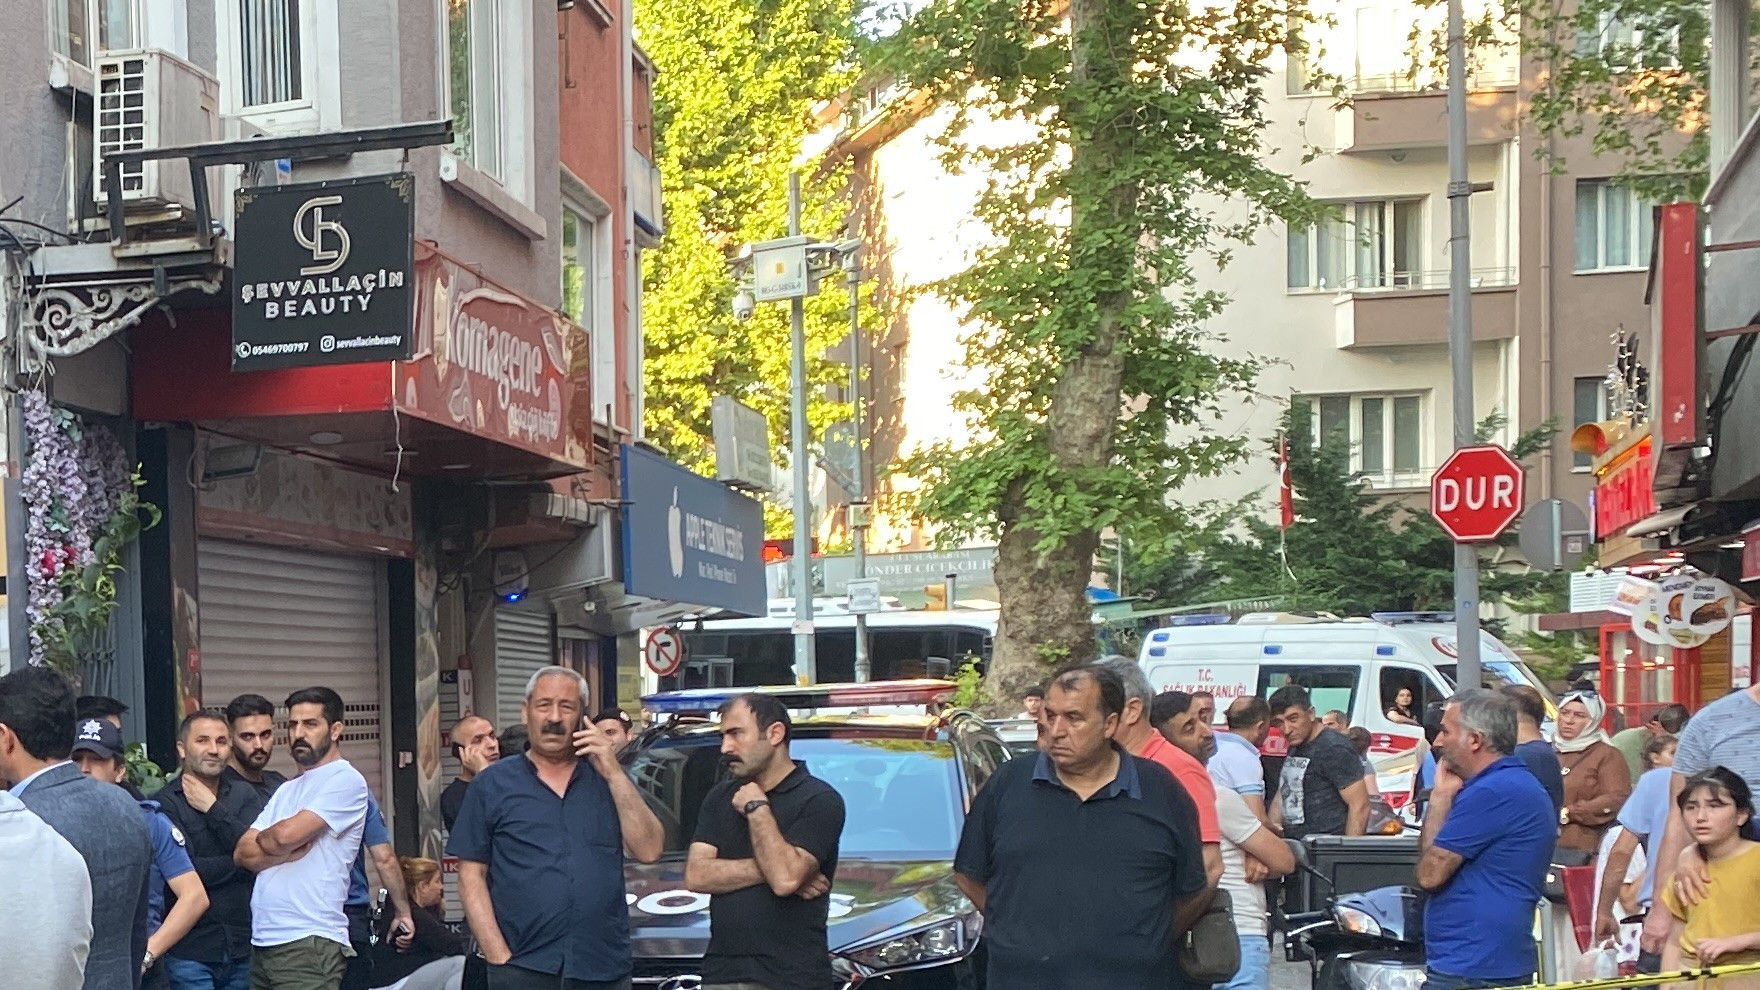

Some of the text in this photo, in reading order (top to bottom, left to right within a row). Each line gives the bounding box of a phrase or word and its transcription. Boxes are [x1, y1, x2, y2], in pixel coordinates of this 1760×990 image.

[242, 269, 403, 303] ŞEVVALLAÇİN
[265, 294, 371, 319] BEAUTY
[1440, 474, 1514, 512] DUR
[1198, 668, 1214, 682] T.C.
